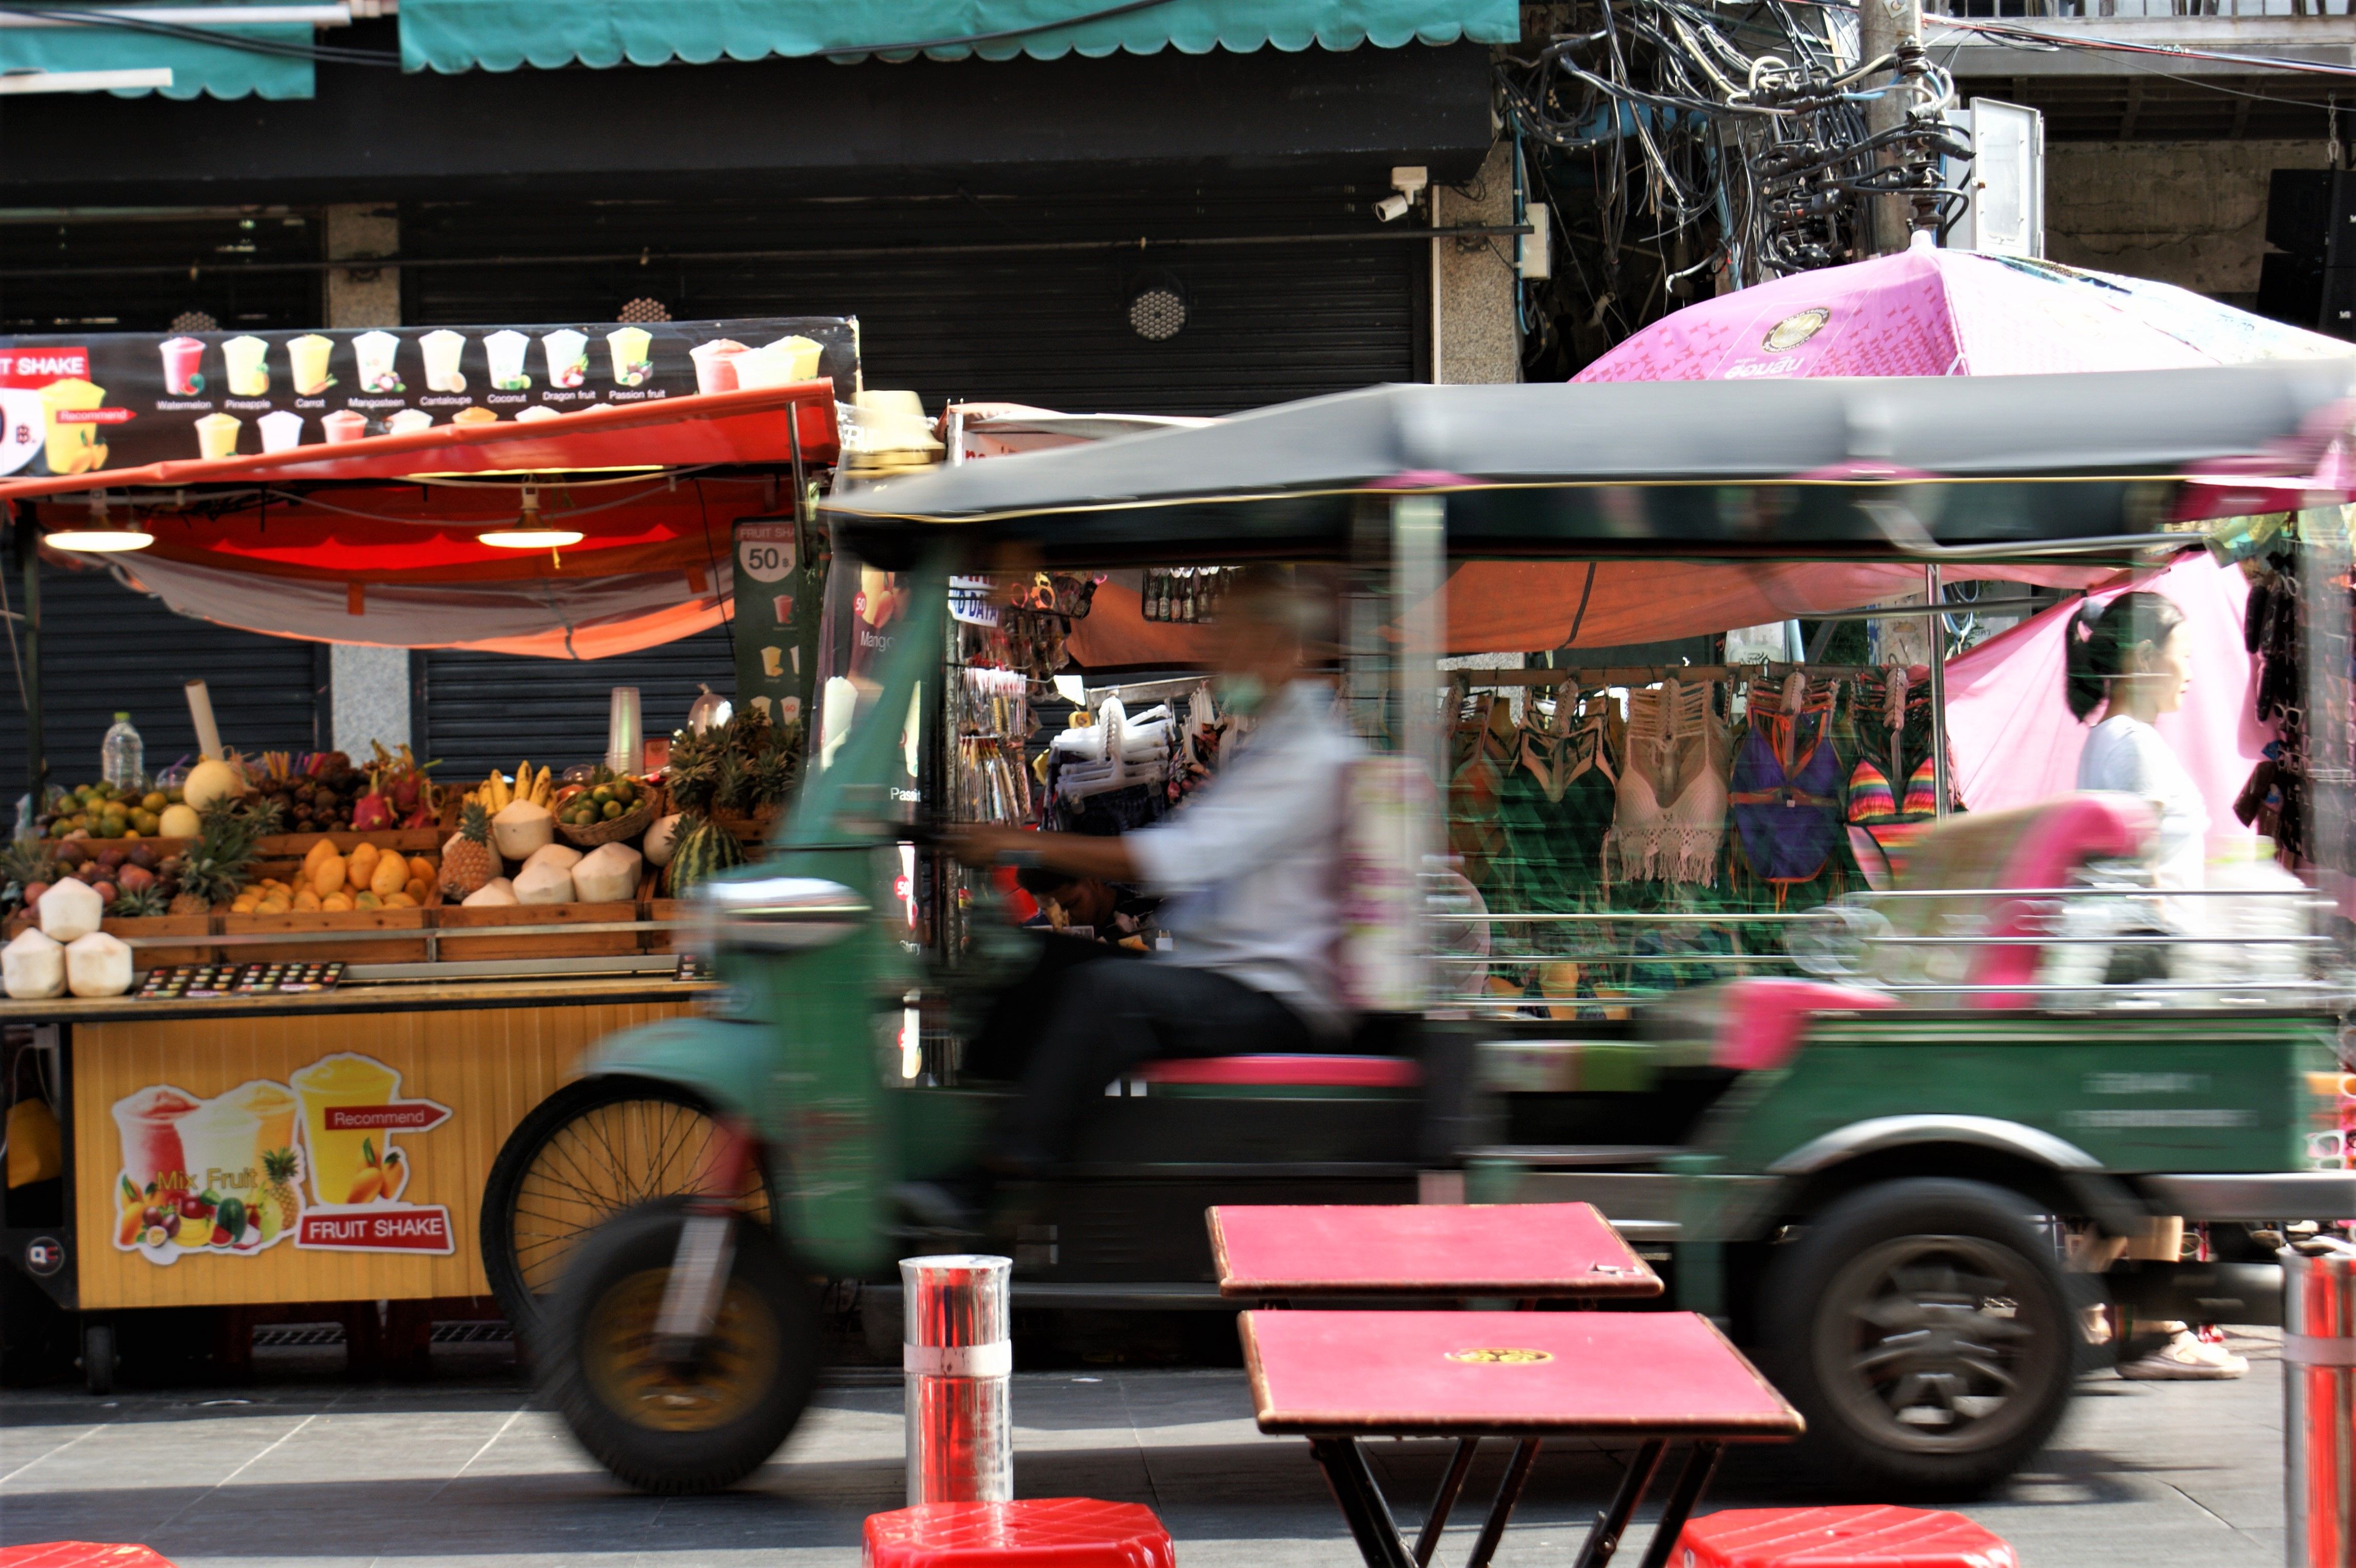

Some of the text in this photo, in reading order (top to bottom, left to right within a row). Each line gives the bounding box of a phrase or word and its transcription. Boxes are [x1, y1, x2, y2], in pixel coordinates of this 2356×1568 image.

[17, 357, 84, 375] SHAKE
[487, 394, 527, 404] Coconut
[542, 390, 596, 402] Dragon fruit
[608, 389, 666, 400] Passion fruit
[156, 400, 212, 410] Watermelon
[224, 399, 271, 410] Pineapple
[295, 398, 326, 408] Carrot
[348, 397, 405, 410] Mangosteen
[420, 396, 472, 406] Cantaloupe
[61, 409, 127, 420] Recommend
[740, 527, 771, 538] FRUIT
[749, 548, 779, 570] 50
[855, 597, 866, 611] 50
[897, 881, 910, 895] 50
[335, 1109, 424, 1125] Recommend
[156, 1167, 258, 1190] Mix Fruit
[309, 1218, 443, 1240] FRUIT SHAKE
